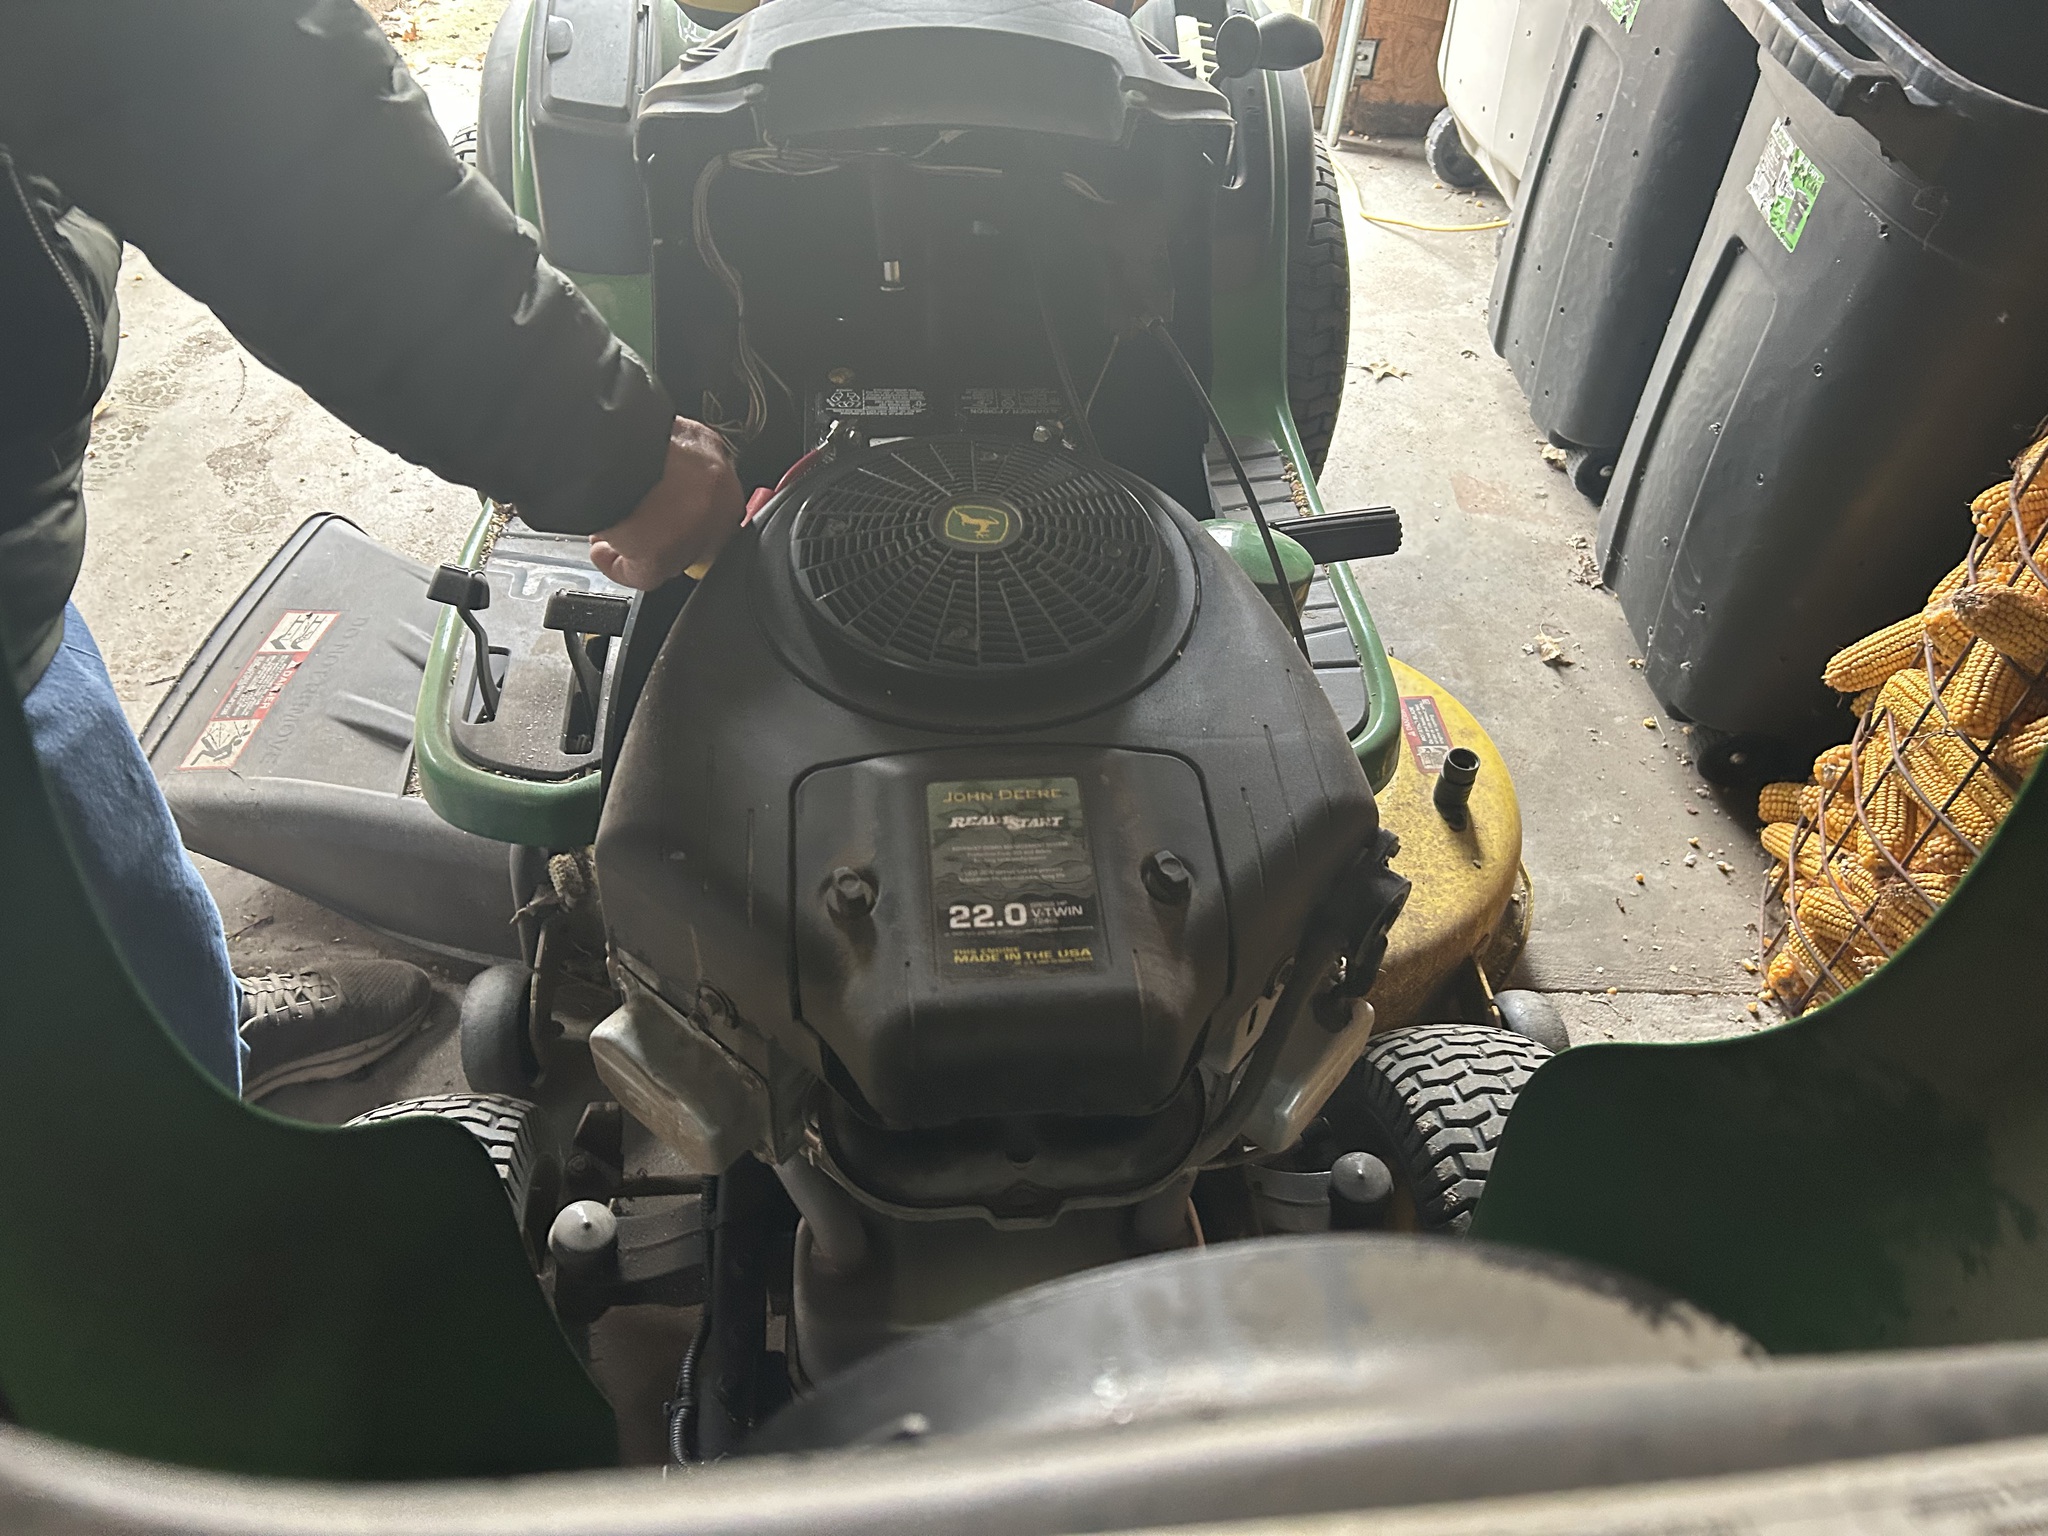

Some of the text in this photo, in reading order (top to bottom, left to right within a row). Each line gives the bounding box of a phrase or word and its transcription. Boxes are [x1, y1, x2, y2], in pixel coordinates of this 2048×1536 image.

[312, 643, 349, 680] NOT
[259, 682, 320, 765] REMOVE
[943, 788, 1061, 803] JOHN DEERE
[949, 902, 1083, 929] 22.0 V-TWIN
[953, 947, 1091, 963] MADE IN THE USA
